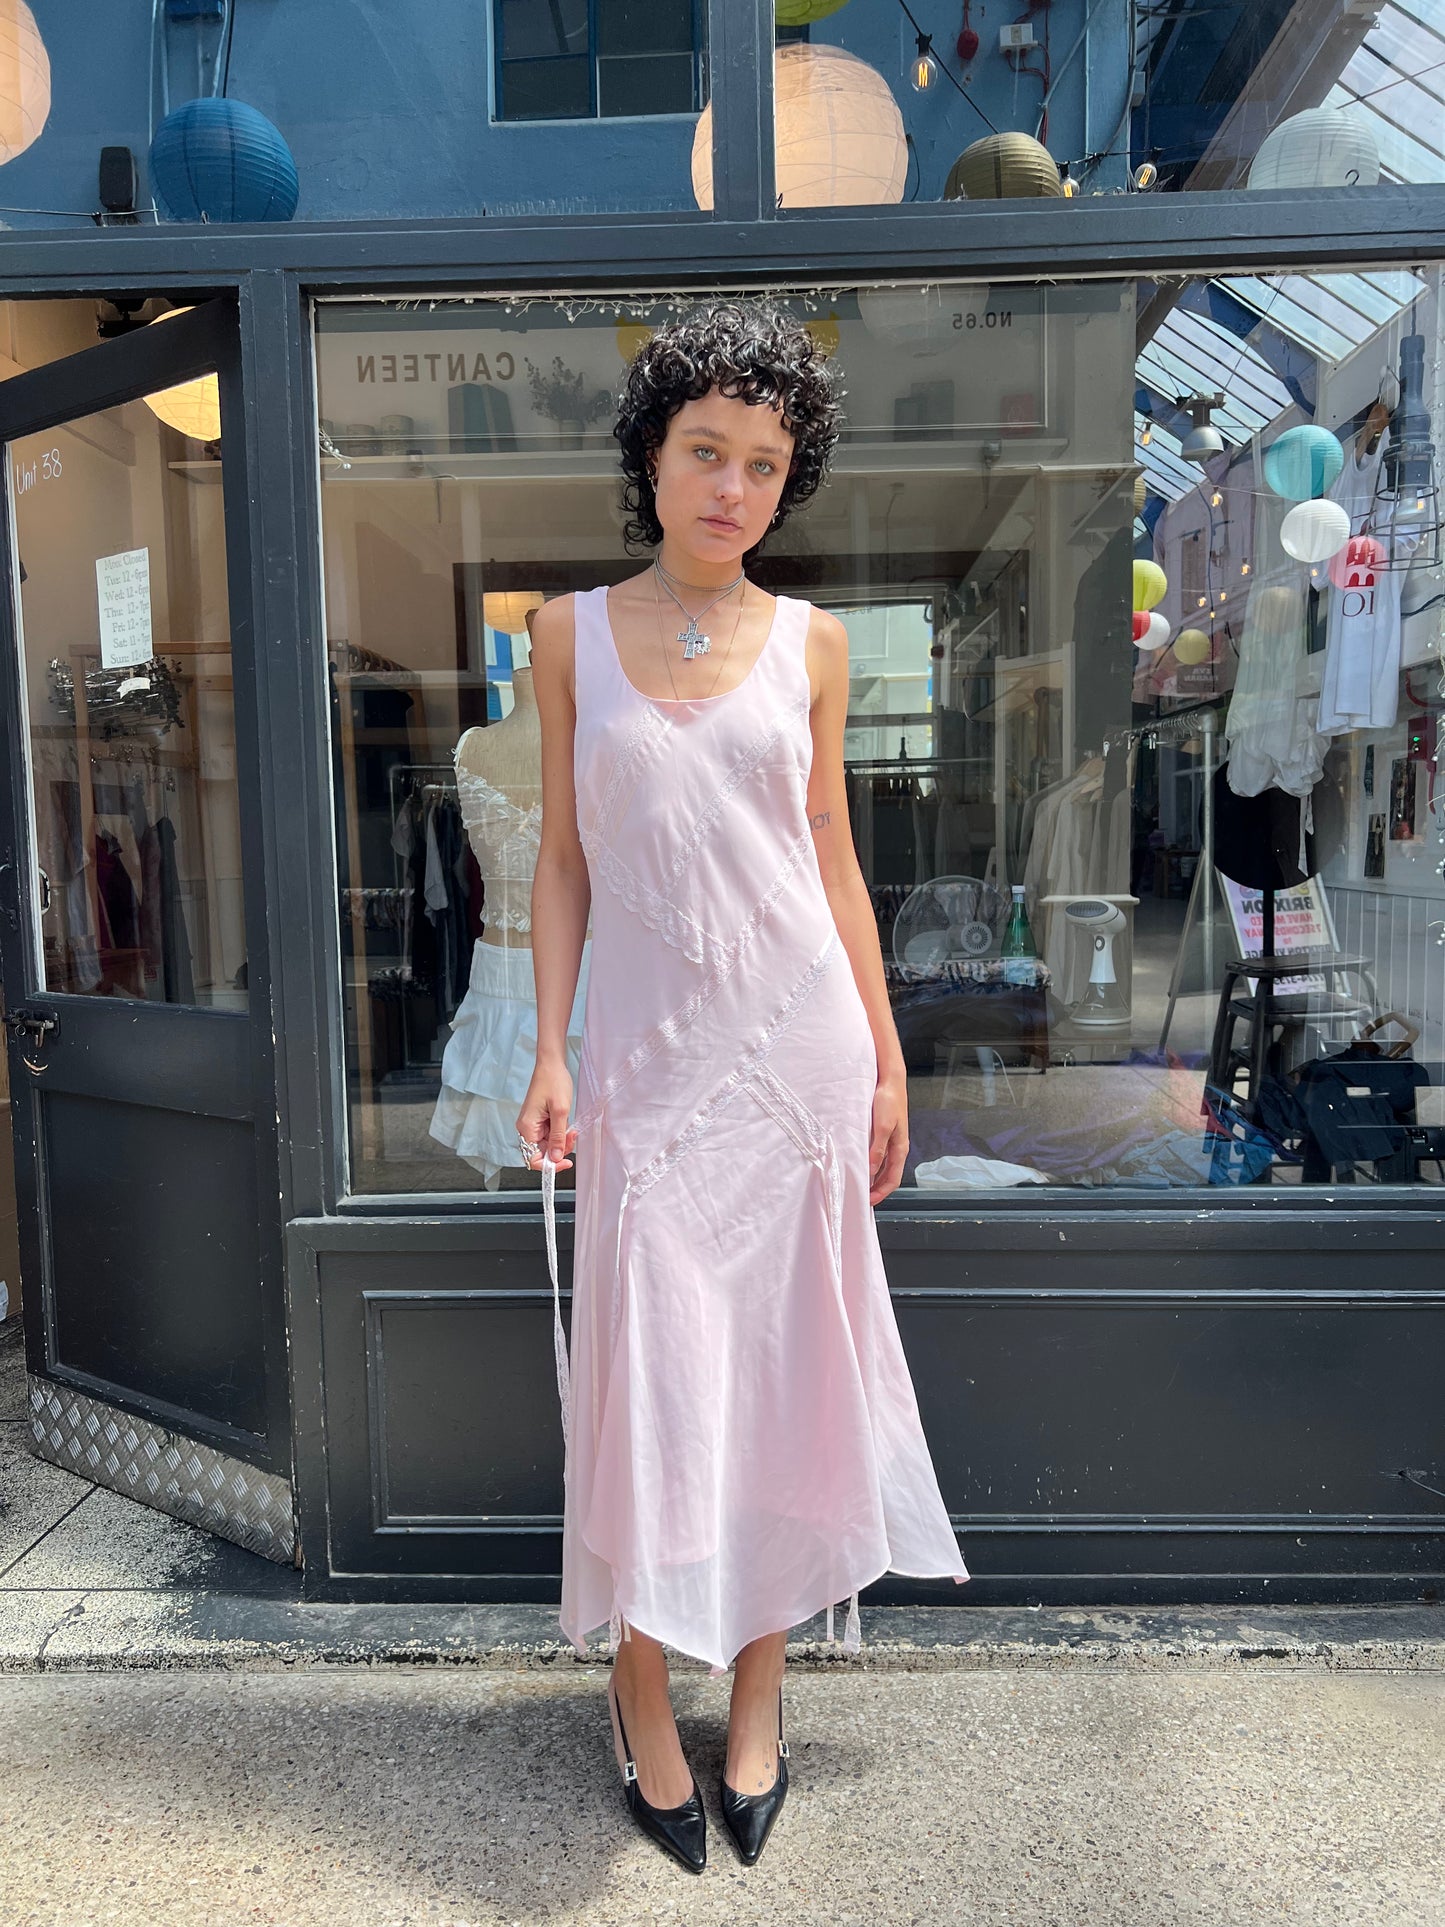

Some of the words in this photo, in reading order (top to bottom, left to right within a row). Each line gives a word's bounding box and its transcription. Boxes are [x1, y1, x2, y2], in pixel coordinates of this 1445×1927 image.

[16, 460, 37, 494] Unit
[42, 448, 62, 480] 38
[122, 550, 146, 566] Closed
[122, 570, 130, 581] 12
[104, 590, 124, 602] Wed:
[126, 586, 134, 598] 12
[128, 602, 135, 614] 12
[112, 622, 125, 633] Fri:
[128, 618, 135, 631] 12
[130, 635, 136, 646] 11
[110, 654, 129, 665] Sun:
[131, 650, 139, 661] 12
